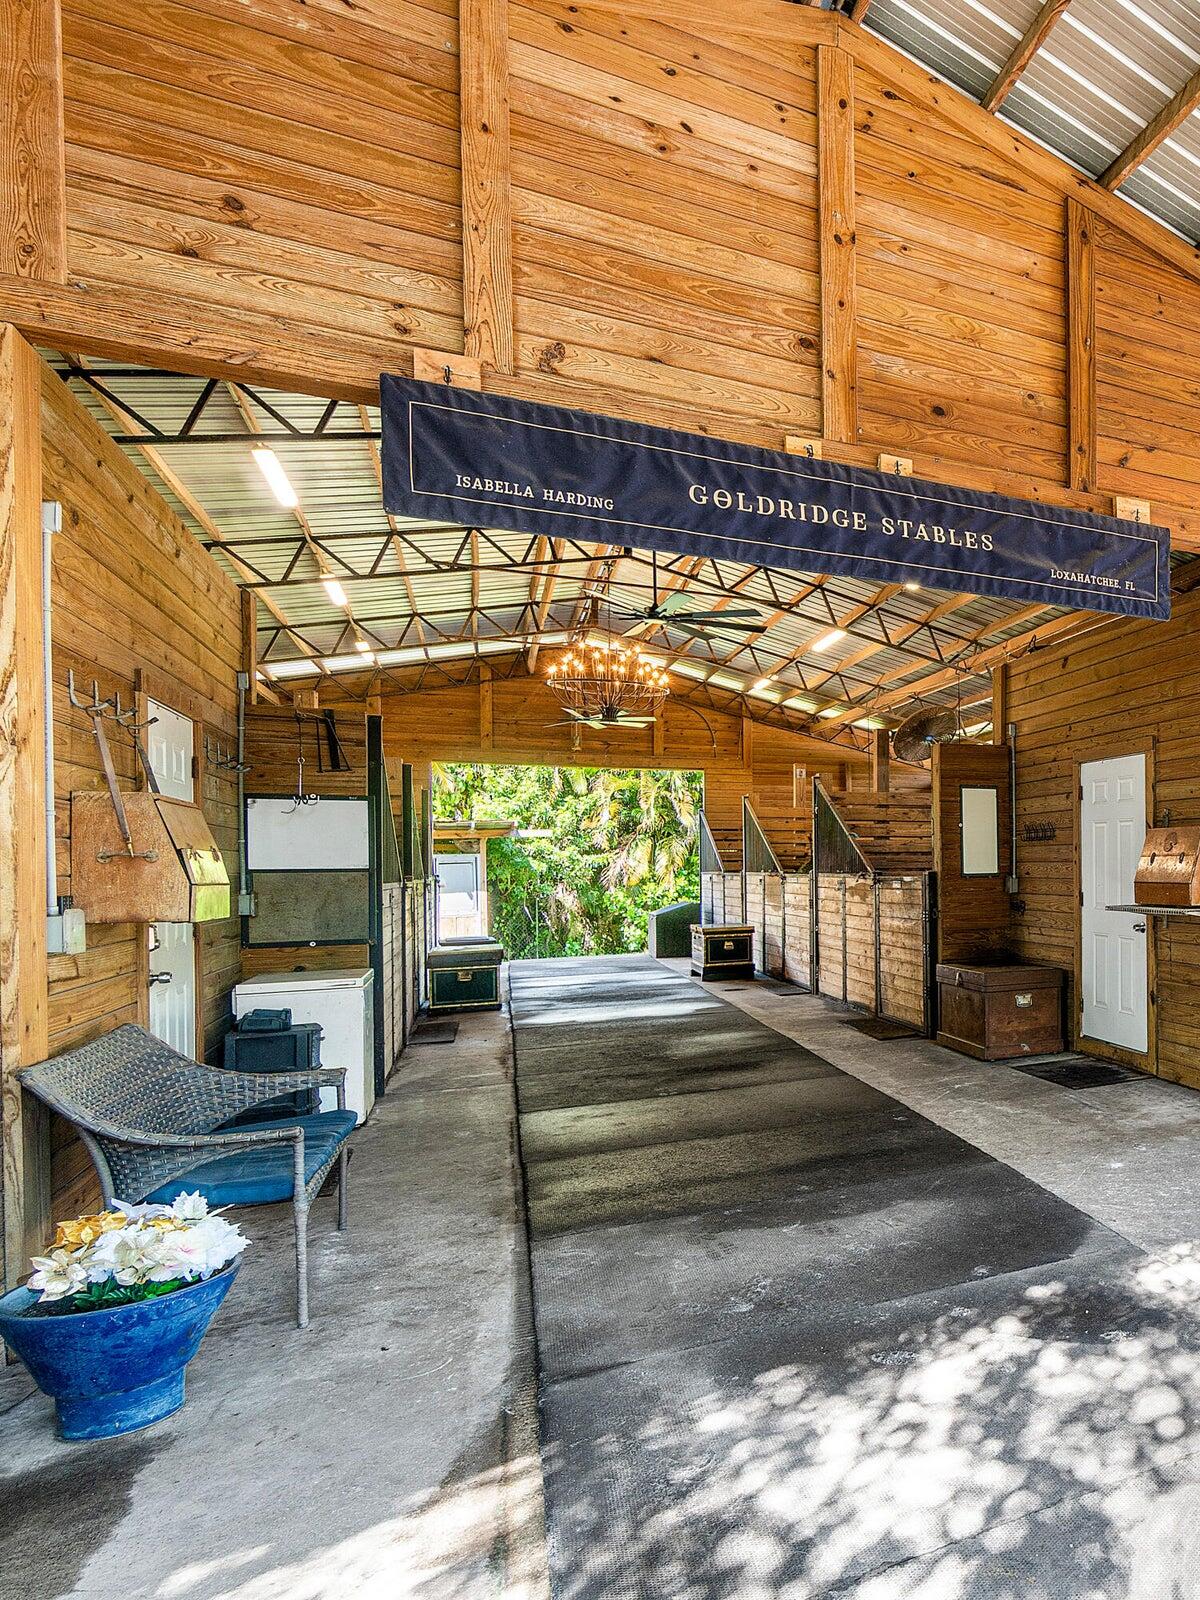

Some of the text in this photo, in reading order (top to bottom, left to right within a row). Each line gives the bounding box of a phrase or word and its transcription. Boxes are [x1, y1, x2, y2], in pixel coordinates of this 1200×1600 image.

[456, 474, 615, 511] ISABELLA HARDING
[881, 517, 994, 551] STABLES
[1125, 580, 1136, 591] FL
